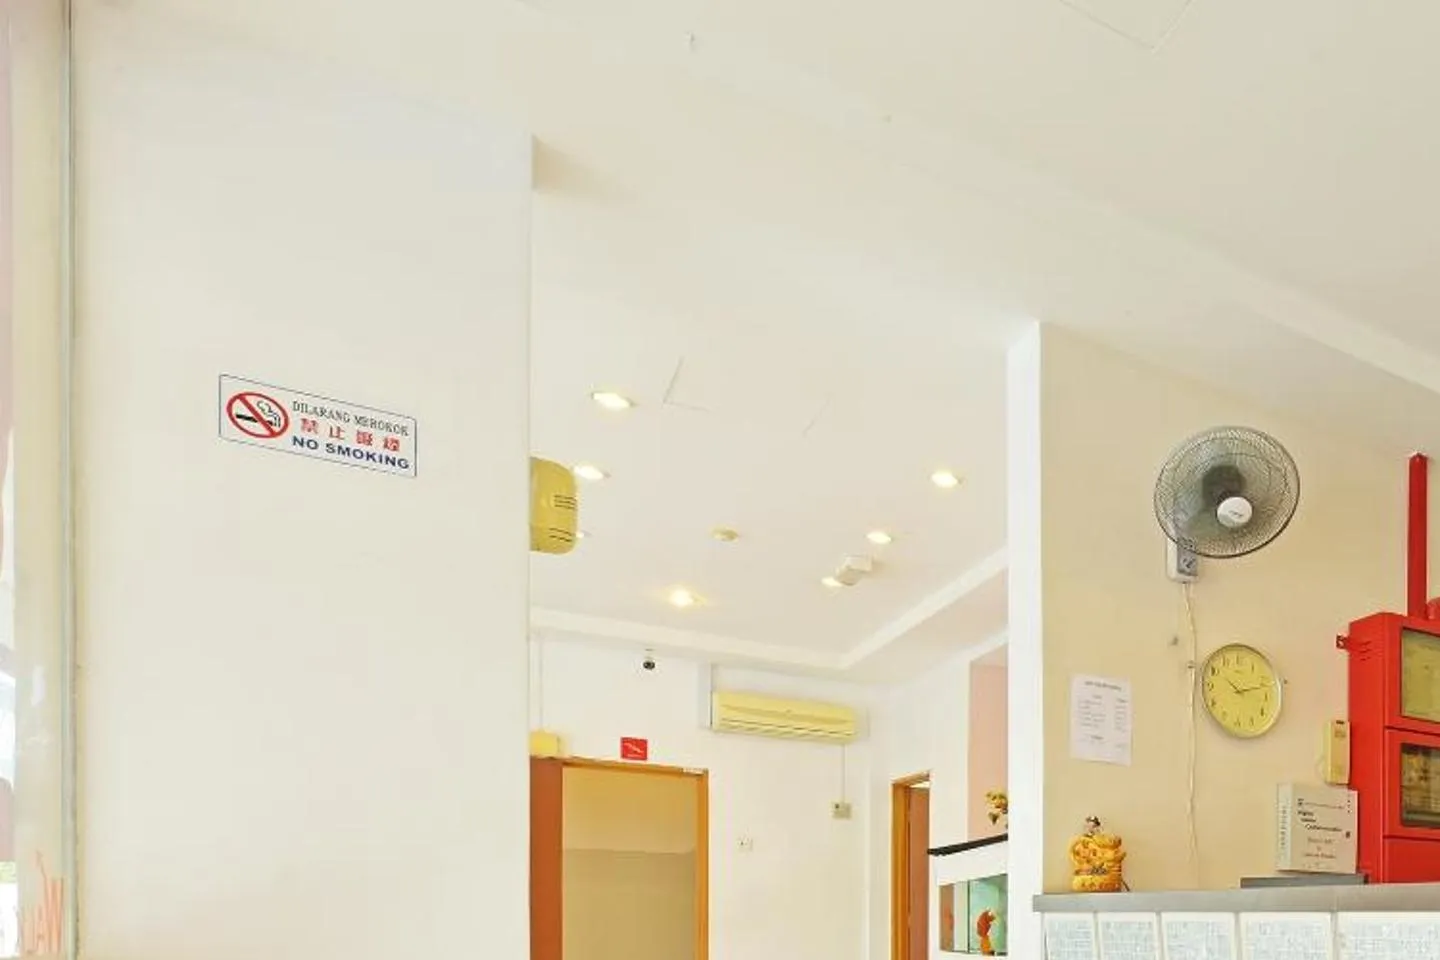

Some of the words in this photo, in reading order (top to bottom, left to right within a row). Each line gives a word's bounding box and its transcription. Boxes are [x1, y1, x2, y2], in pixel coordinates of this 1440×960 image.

[292, 400, 350, 423] DILARANG
[293, 435, 319, 450] NO
[326, 443, 409, 469] SMOKING
